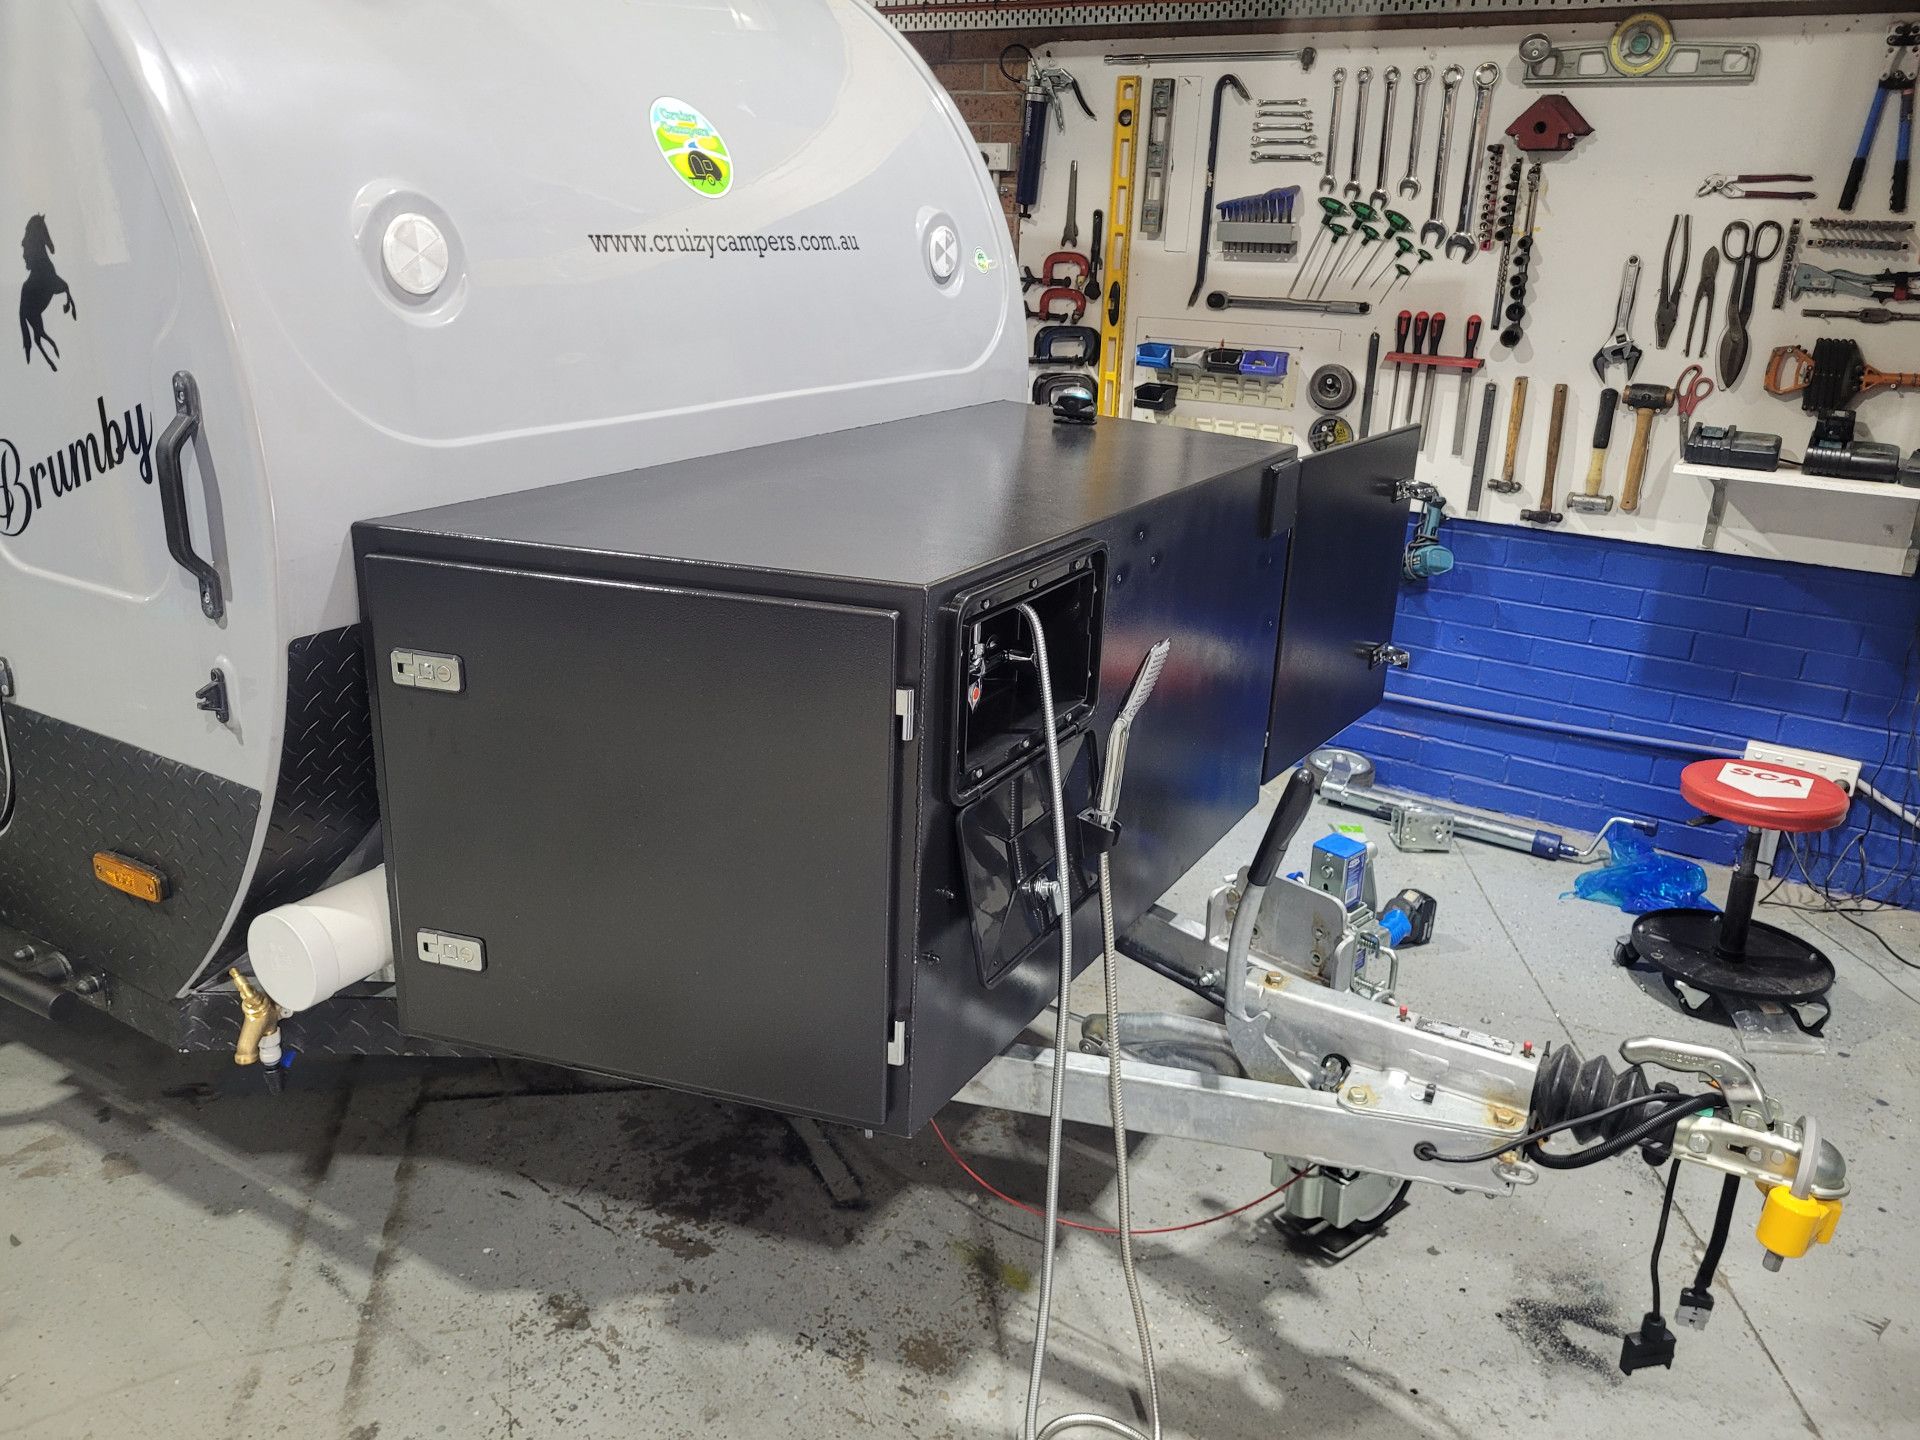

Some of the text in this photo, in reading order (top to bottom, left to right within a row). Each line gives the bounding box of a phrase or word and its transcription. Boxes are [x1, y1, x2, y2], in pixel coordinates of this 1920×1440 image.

[588, 228, 860, 258] www.cruizycampers.com.au
[0, 395, 153, 536] Brumby
[1730, 767, 1802, 787] SCA
